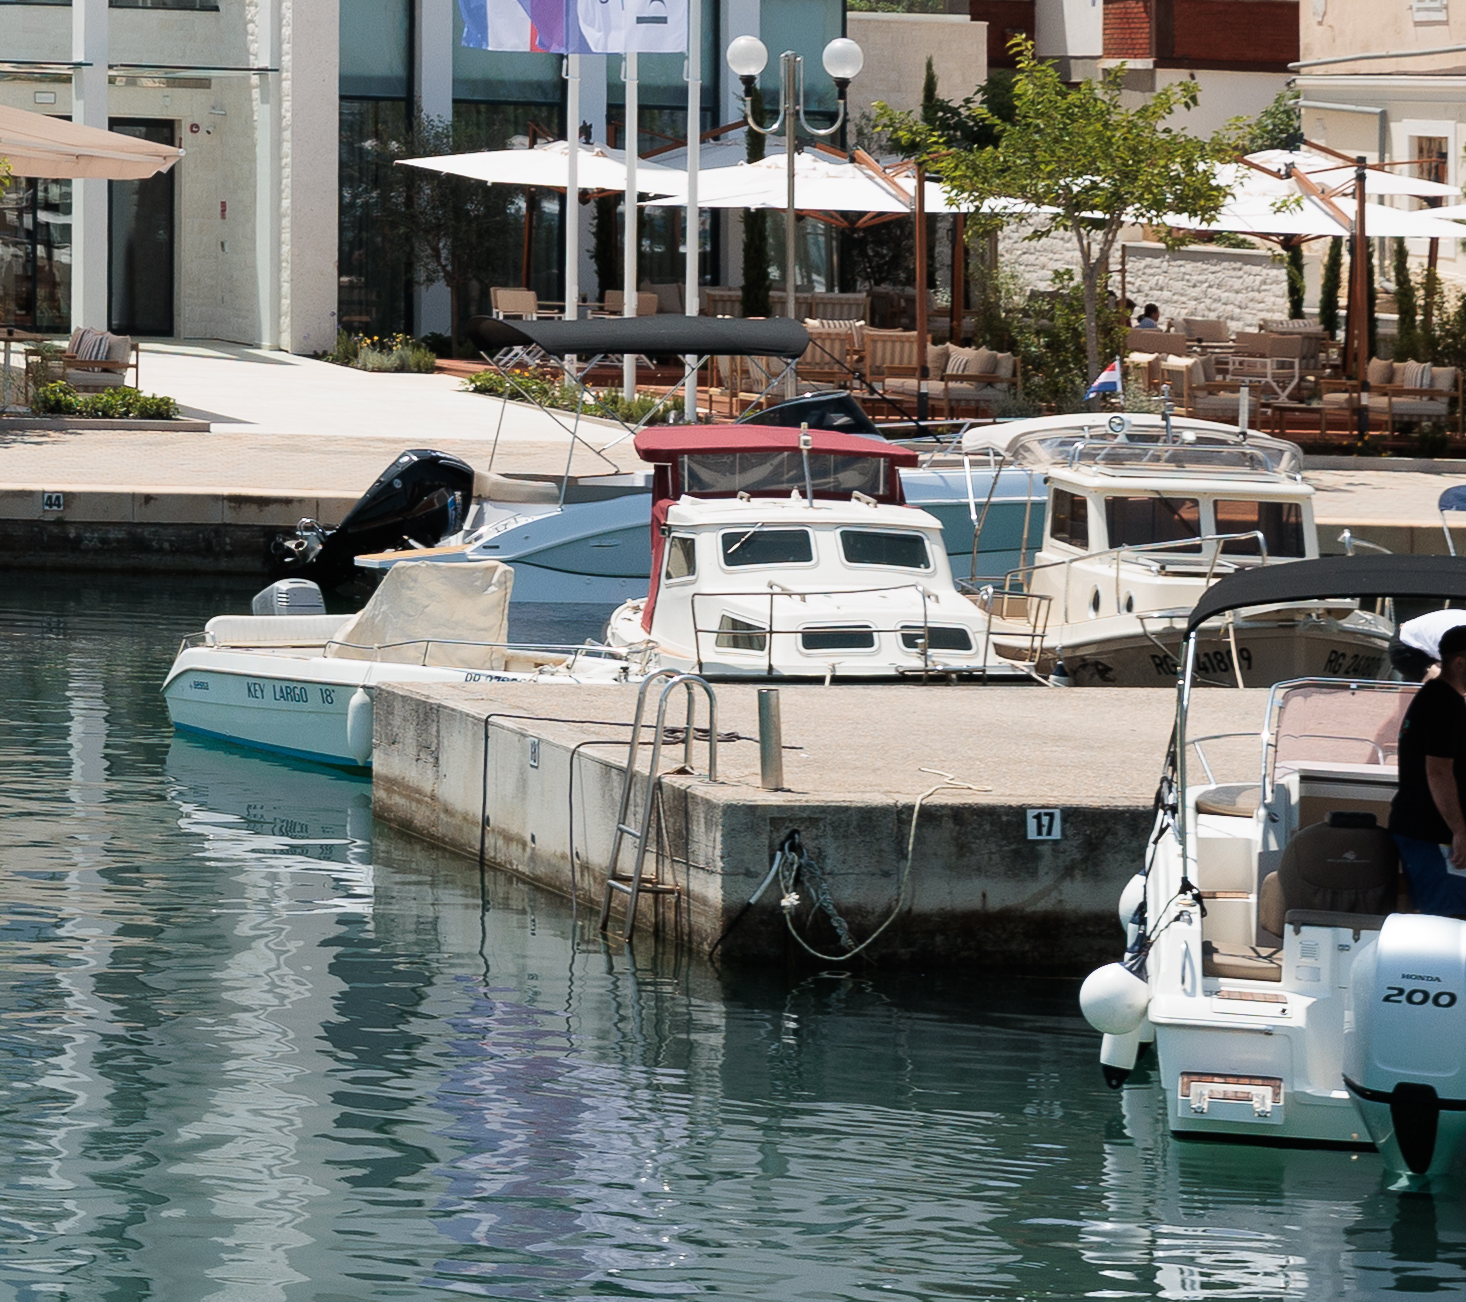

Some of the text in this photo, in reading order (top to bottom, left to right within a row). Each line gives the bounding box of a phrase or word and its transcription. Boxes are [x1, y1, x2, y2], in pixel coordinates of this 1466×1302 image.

[45, 495, 62, 509] 44
[1323, 649, 1346, 674] RG
[246, 681, 265, 699] KEY
[273, 684, 308, 703] LARGO
[1032, 812, 1055, 836] 17
[1401, 974, 1442, 983] HONDA
[1382, 986, 1457, 1008] 200
